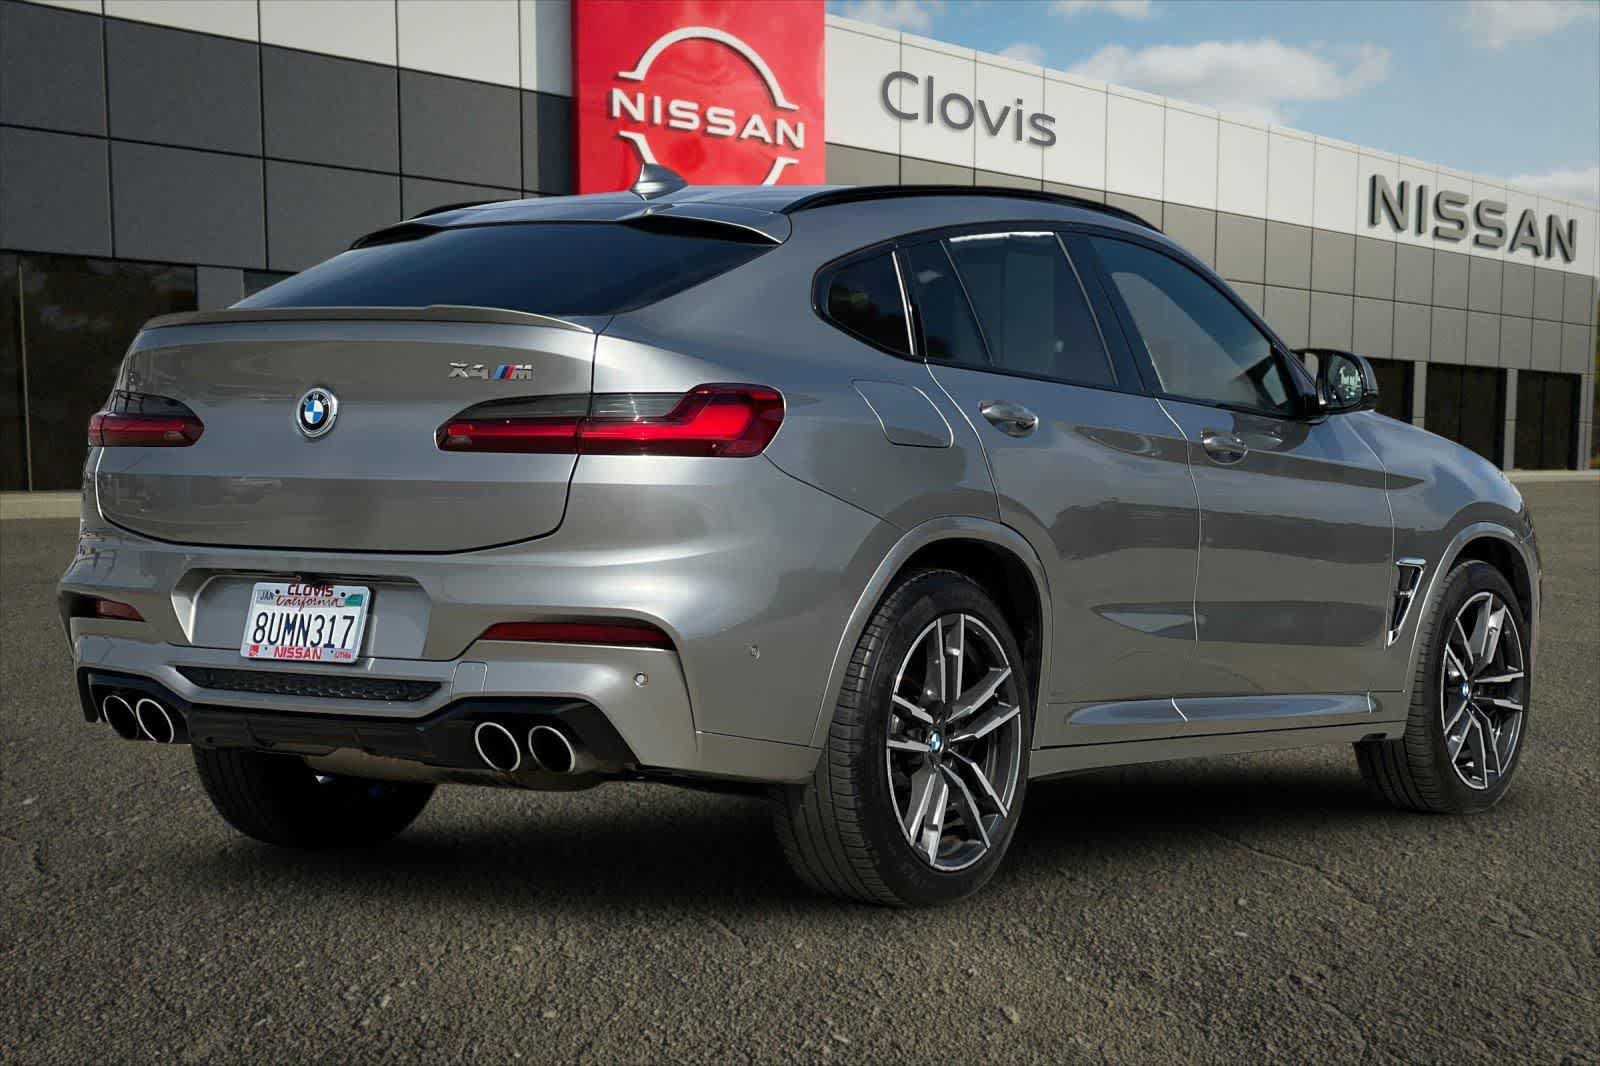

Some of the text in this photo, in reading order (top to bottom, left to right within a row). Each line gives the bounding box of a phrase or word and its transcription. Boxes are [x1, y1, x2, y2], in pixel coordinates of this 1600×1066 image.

[611, 87, 806, 149] NISSAN
[881, 70, 1057, 147] Clovis
[1368, 173, 1578, 263] NISSAN
[275, 595, 345, 611] California
[288, 584, 334, 597] CLOVIS
[252, 611, 355, 649] 8UMN317
[274, 646, 322, 660] NISSAN
